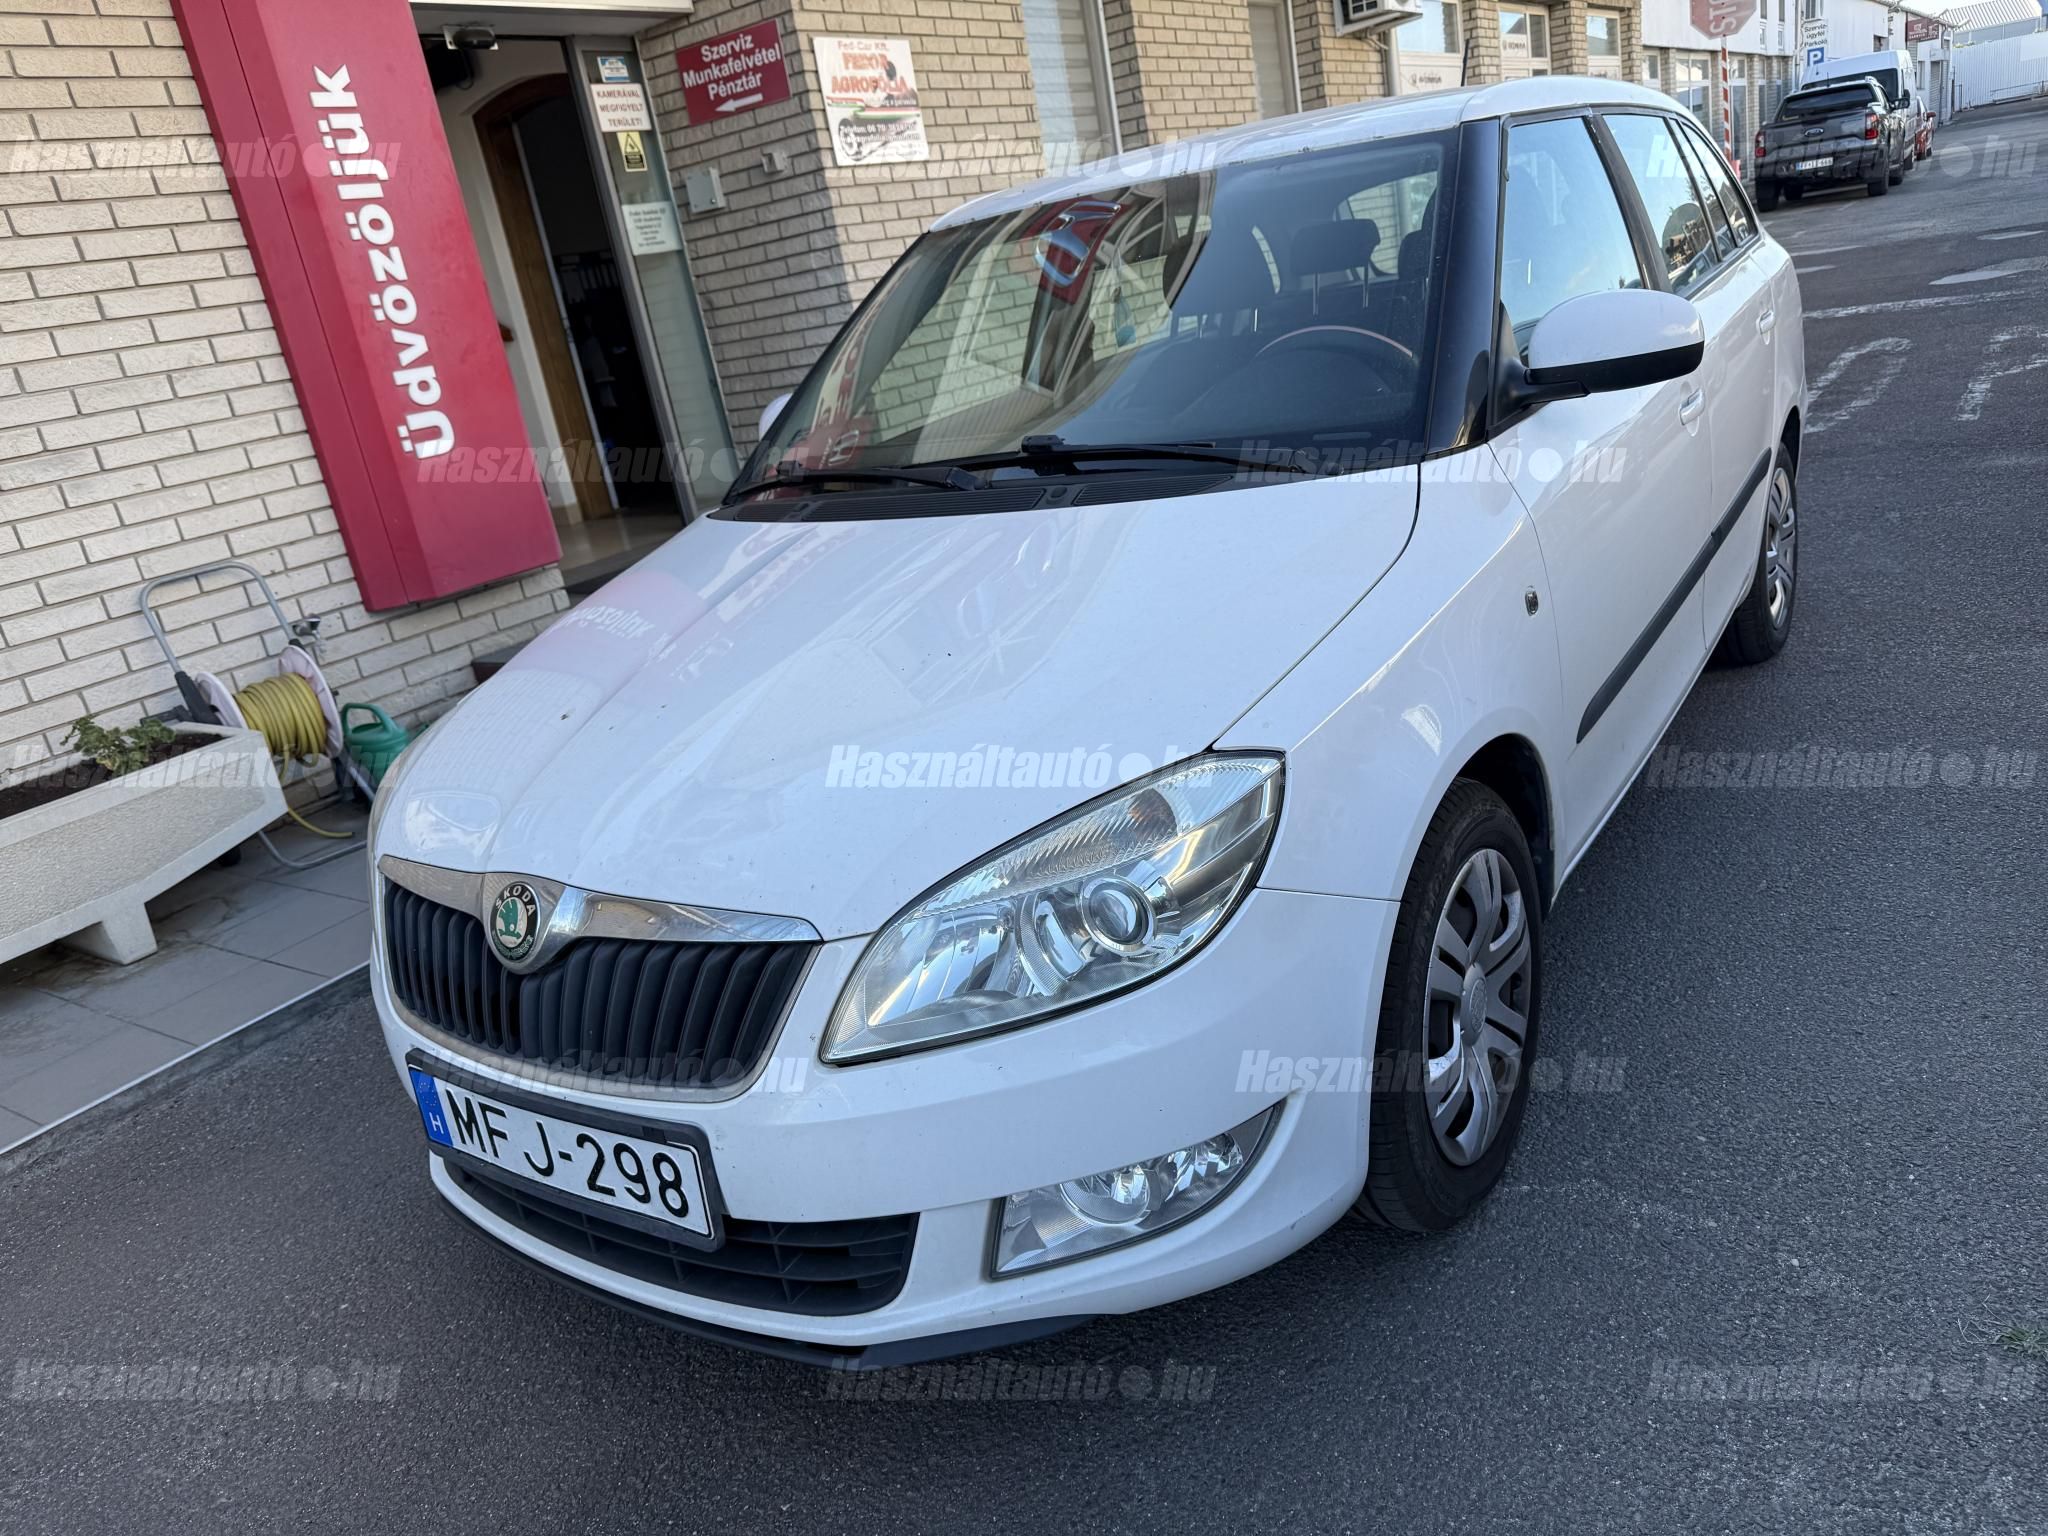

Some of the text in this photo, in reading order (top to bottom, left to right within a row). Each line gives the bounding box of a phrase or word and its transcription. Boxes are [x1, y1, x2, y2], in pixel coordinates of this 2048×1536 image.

[1709, 0, 1737, 33] ST
[701, 33, 755, 62] Szerviz
[1810, 50, 1822, 66] P
[682, 42, 781, 88] Munkafelvétel
[707, 71, 763, 100] Pénztár
[310, 64, 456, 460] Üdvözöljük
[429, 1112, 444, 1135] H
